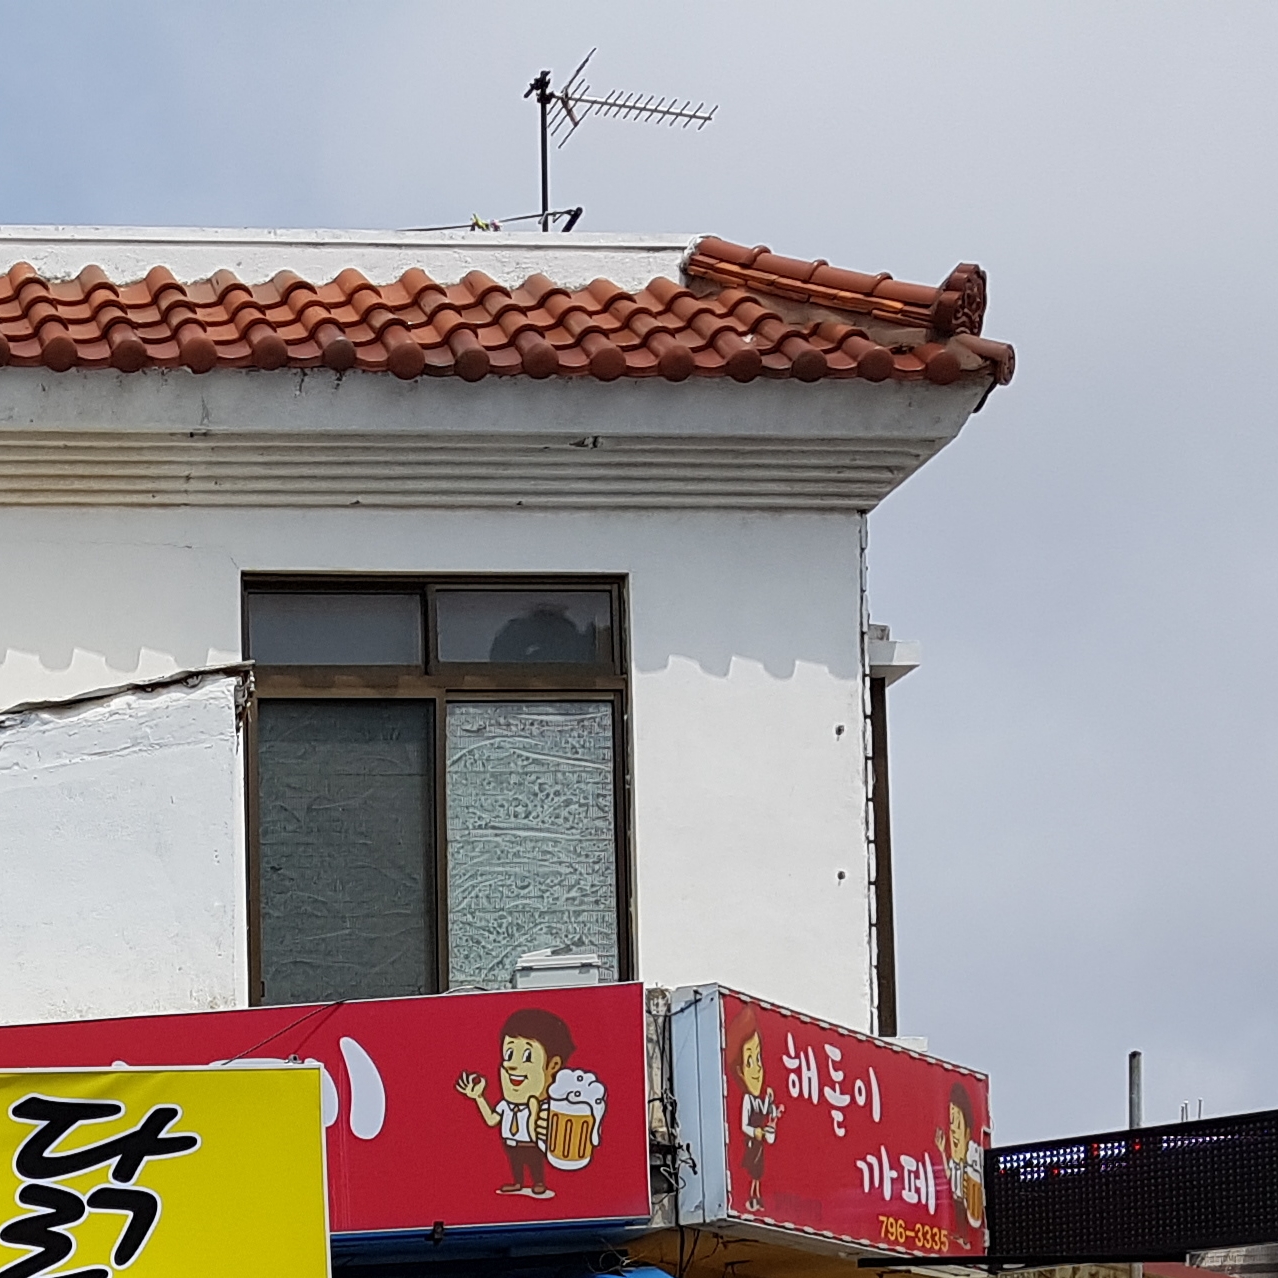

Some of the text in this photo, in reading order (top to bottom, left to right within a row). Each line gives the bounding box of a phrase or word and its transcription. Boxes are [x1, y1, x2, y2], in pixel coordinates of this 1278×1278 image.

[783, 1032, 881, 1137] 해돋이
[856, 1145, 935, 1215] 까페
[879, 1216, 948, 1251] 796-3335
